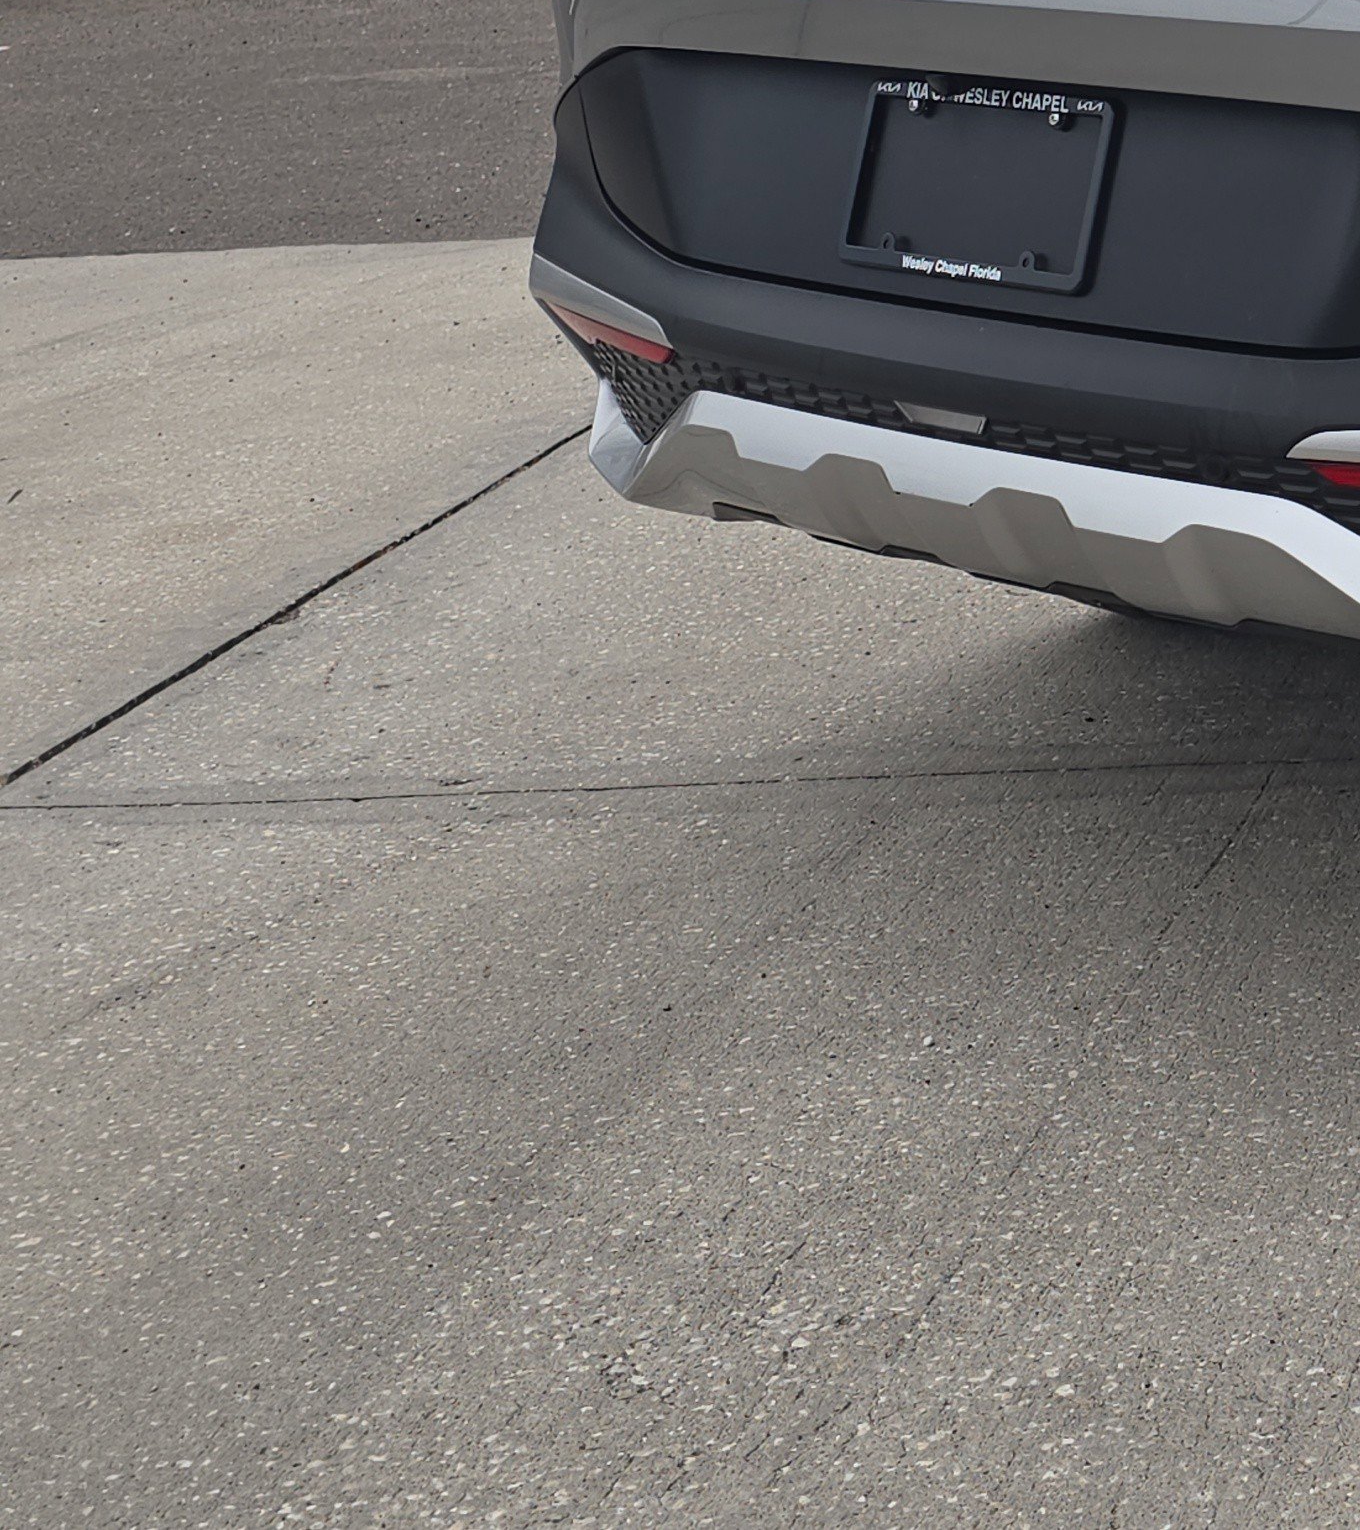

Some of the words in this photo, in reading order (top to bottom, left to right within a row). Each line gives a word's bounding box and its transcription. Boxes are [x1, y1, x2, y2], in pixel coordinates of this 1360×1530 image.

[906, 81, 929, 100] KIA
[1012, 91, 1069, 113] CHAPEL
[902, 254, 935, 274] Wesley
[935, 259, 968, 278] Chapel
[968, 264, 1002, 281] Florida
